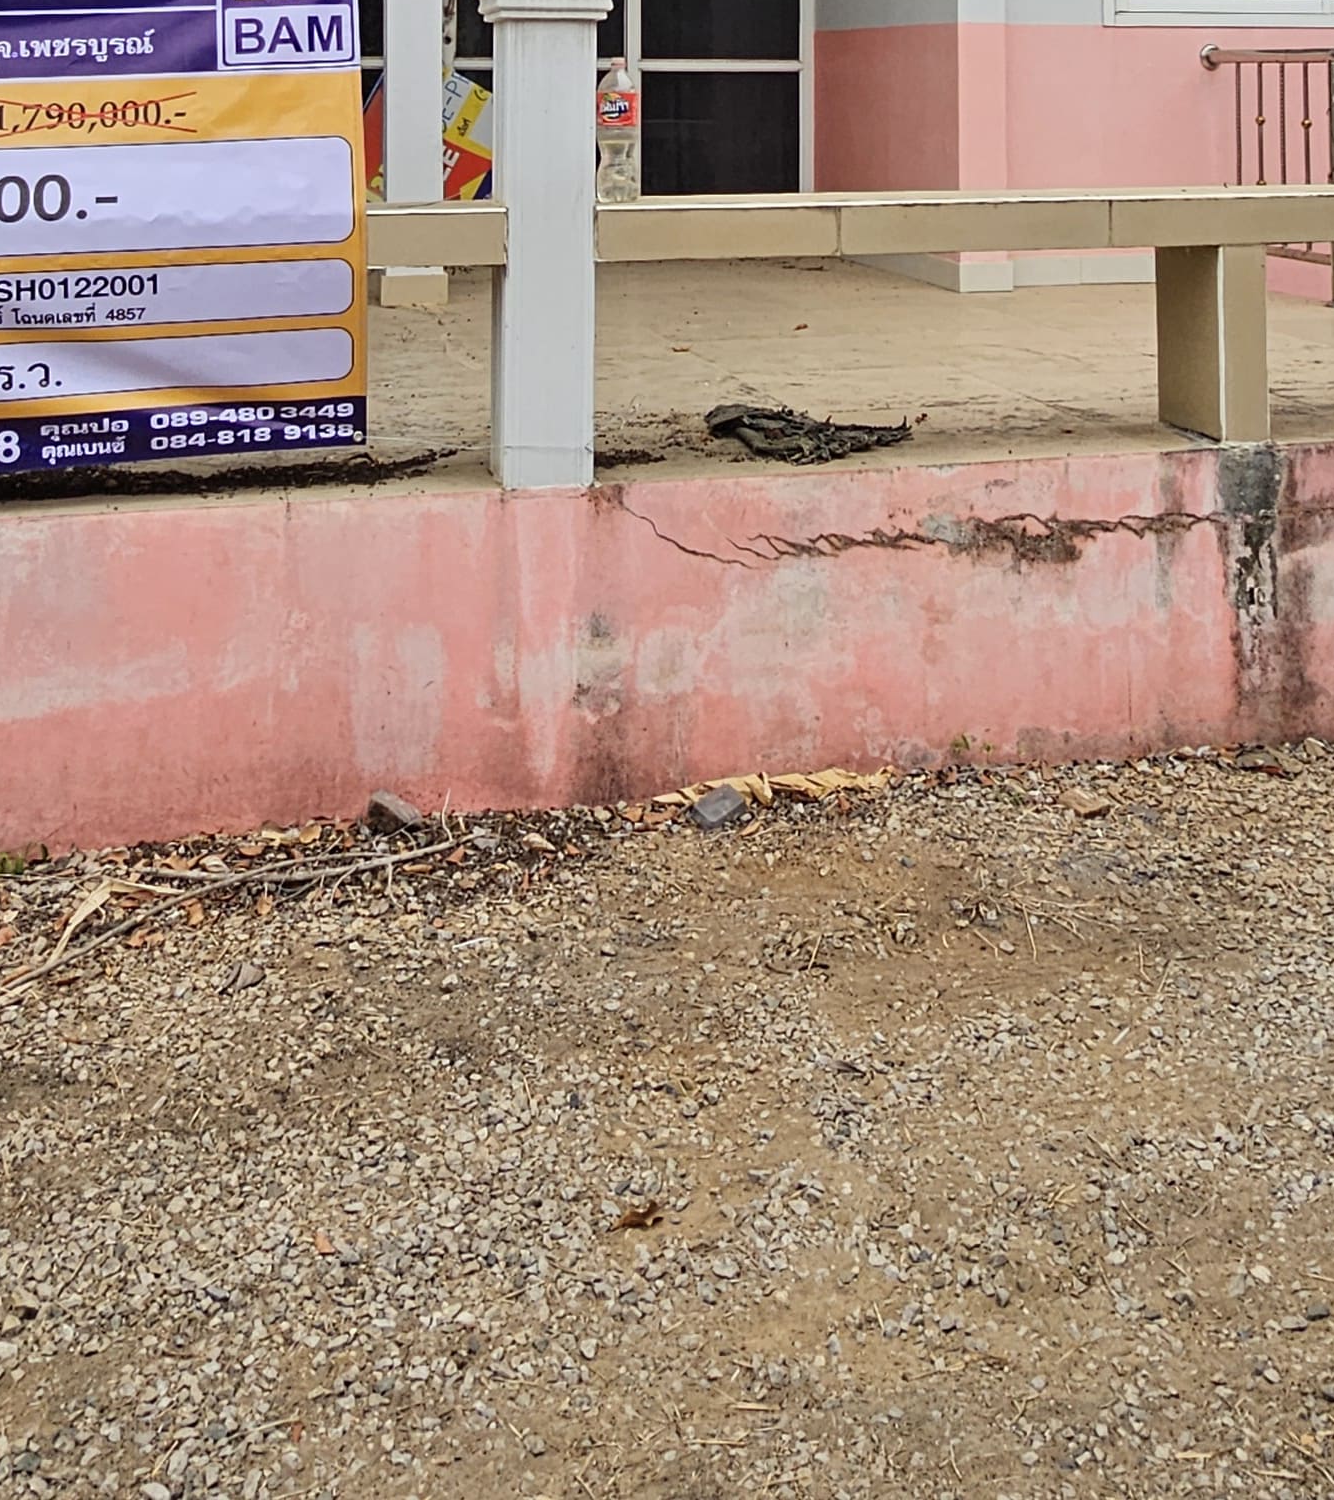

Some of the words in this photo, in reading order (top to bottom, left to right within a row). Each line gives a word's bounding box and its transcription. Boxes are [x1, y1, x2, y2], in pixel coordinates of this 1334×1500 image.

[233, 15, 344, 55] BAM
[11, 303, 96, 326] โฉนดเลขที่
[105, 307, 146, 321] 4857
[40, 417, 129, 442] คุณปอ
[150, 427, 272, 451] 084-818
[284, 423, 355, 441] 9138
